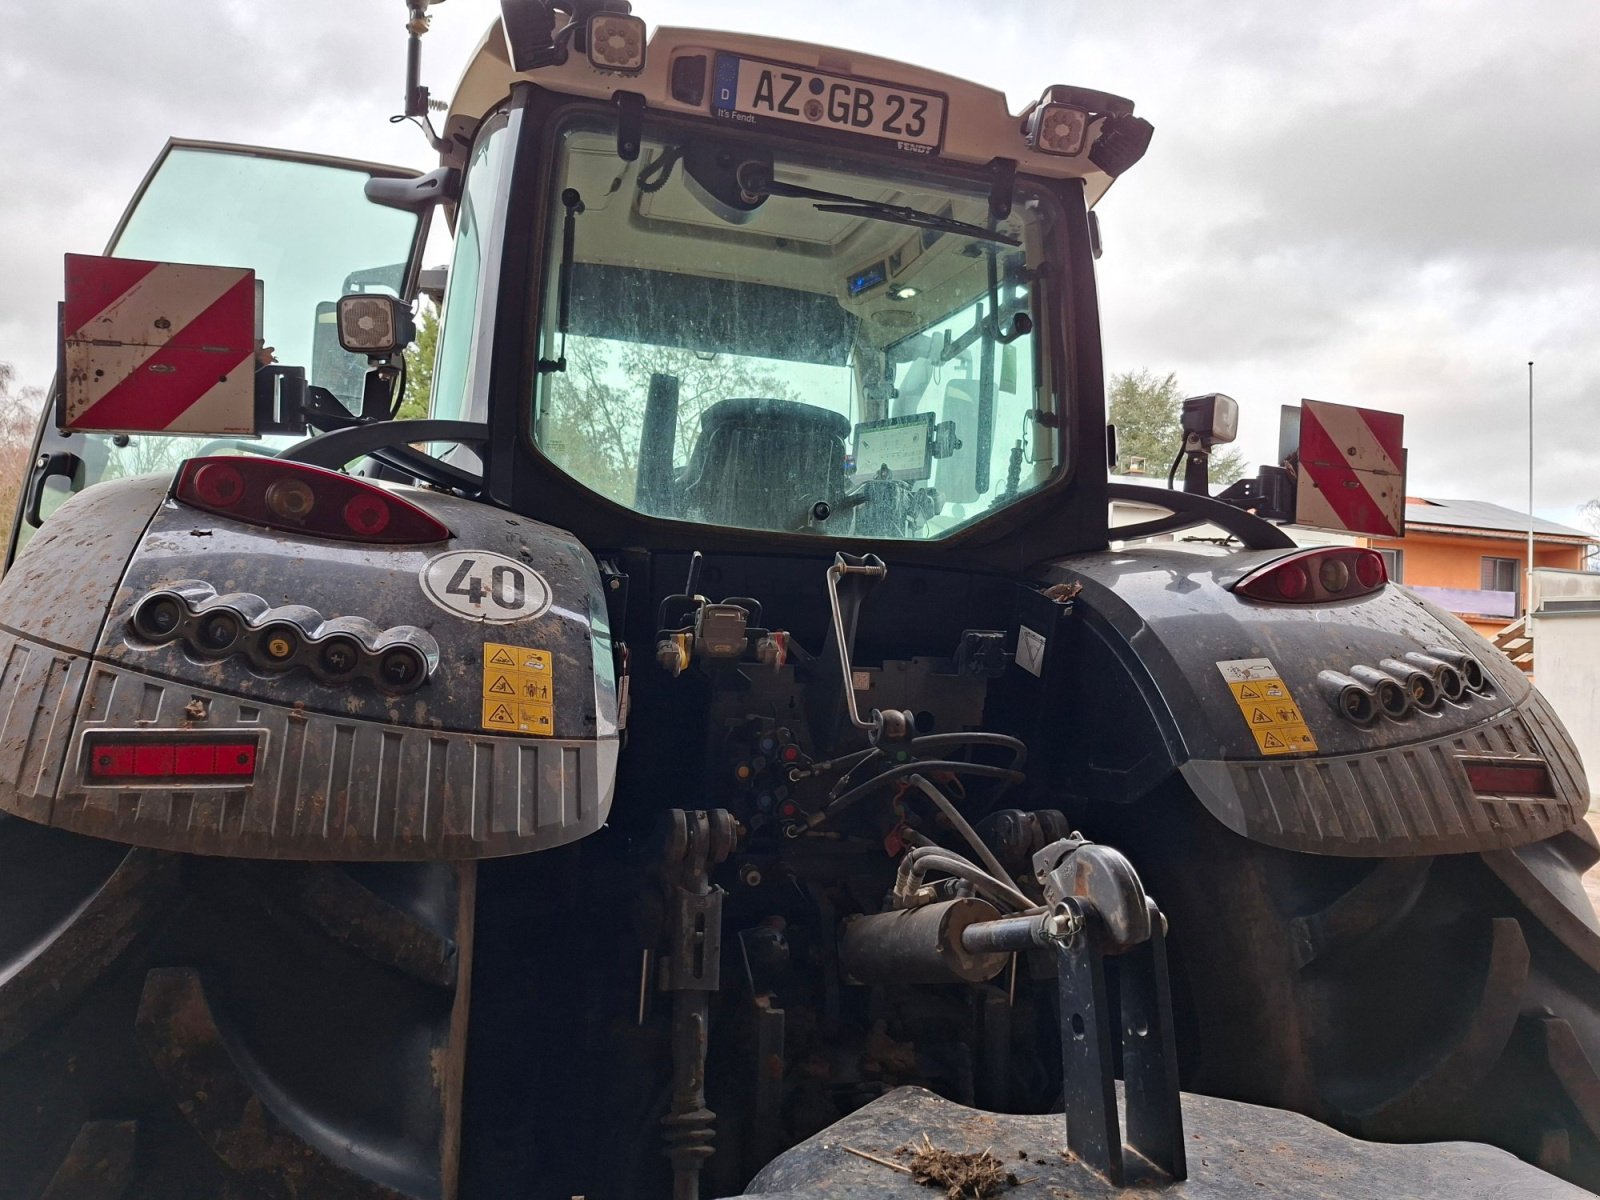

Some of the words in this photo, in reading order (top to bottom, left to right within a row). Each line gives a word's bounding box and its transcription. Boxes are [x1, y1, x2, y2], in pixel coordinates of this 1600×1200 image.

[721, 88, 730, 100] D
[752, 70, 802, 116] AZ
[828, 83, 875, 128] GB
[882, 94, 928, 138] 23
[717, 108, 730, 119] It's
[897, 141, 933, 154] FENDT
[445, 559, 525, 610] 40
